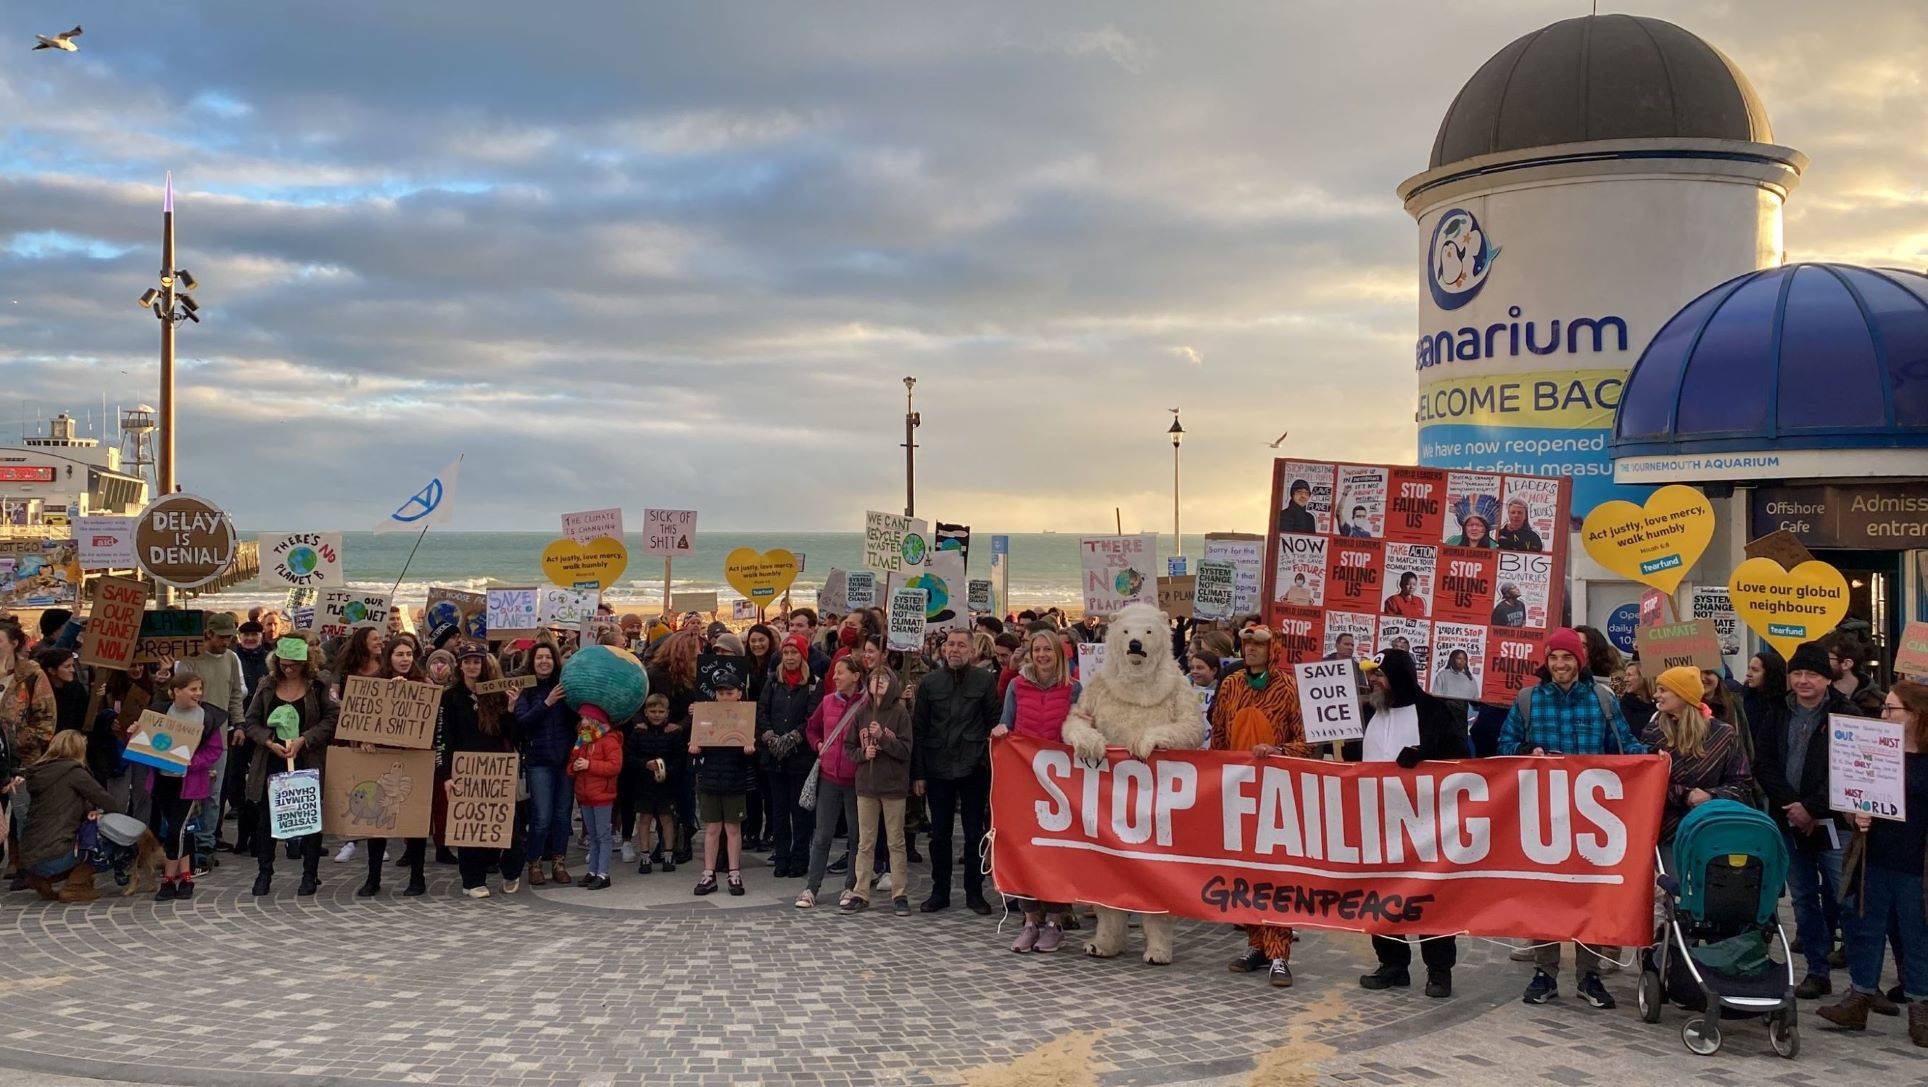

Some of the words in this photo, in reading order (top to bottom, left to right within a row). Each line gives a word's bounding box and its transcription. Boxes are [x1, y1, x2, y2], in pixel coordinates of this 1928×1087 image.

[1416, 384, 1520, 423] ELCOME
[1534, 378, 1622, 411] BAC
[1435, 442, 1461, 457] have
[1465, 441, 1500, 455] now
[1505, 434, 1604, 456] reopened
[1540, 463, 1613, 476] measu
[1704, 457, 1779, 469] AQUARIUM
[1401, 482, 1433, 499] STOP
[1392, 497, 1439, 515] FAILING
[1766, 502, 1825, 515] Offshore
[1852, 494, 1928, 513] Admiss
[152, 511, 223, 535] DELAY
[565, 517, 581, 527] THE
[584, 512, 616, 523] CLIMATE
[650, 511, 673, 522] SICK
[680, 512, 691, 523] OF
[867, 514, 882, 525] WE
[1406, 513, 1423, 529] US
[1588, 528, 1608, 542] Act
[1610, 521, 1644, 538] justly,
[1645, 514, 1668, 527] love
[1670, 505, 1705, 520] mercy,
[660, 524, 677, 535] THIS
[1780, 520, 1810, 533] Cafe
[175, 532, 190, 546] IS
[650, 536, 676, 549] SHIT
[867, 527, 901, 543] RECYCLE
[1617, 533, 1645, 548] walk
[1645, 523, 1686, 540] humbly
[16, 542, 40, 553] EGO
[273, 533, 320, 555] THERE'S
[319, 544, 336, 564] NO
[1084, 540, 1143, 553] THERE
[1208, 545, 1228, 555] Sorry
[1231, 545, 1241, 554] for
[1281, 537, 1325, 554] NOW
[1409, 545, 1436, 558] ACTION
[149, 545, 227, 566] DENIAL
[1106, 554, 1130, 568] IS
[1340, 551, 1371, 568] STOP
[582, 561, 608, 570] humbly
[728, 565, 740, 573] Act
[1200, 567, 1231, 576] SYSTEM
[1293, 564, 1325, 579] FUTURE
[1450, 560, 1482, 578] STOP
[1500, 554, 1551, 574] BIG
[1642, 556, 1680, 573] tearfund
[274, 563, 312, 585] PLANET
[313, 570, 325, 581] B
[759, 570, 781, 578] humbly
[1199, 575, 1232, 583] CHANGE
[1332, 566, 1377, 584] FAILING
[1498, 572, 1548, 583] COUNTRIES
[1199, 581, 1214, 589] NOT
[1345, 582, 1361, 597] US
[1442, 576, 1489, 595] FAILING
[1736, 581, 1766, 594] Love
[1769, 586, 1792, 595] our
[1796, 586, 1841, 599] global
[102, 585, 144, 607] SAVE
[327, 592, 352, 603] IT'S
[364, 597, 384, 608] OUR
[489, 591, 531, 610] SAVE
[894, 596, 924, 605] SYSTEM
[1198, 589, 1232, 598] CLIMATE
[1198, 596, 1231, 605] CHANGE
[1454, 593, 1473, 608] US
[103, 604, 135, 623] OUR
[500, 606, 521, 615] OUR
[893, 603, 924, 612] CHANGE
[1694, 603, 1735, 612] CHANGE
[1694, 611, 1713, 619] NOT
[1749, 599, 1826, 616] neighbours
[487, 612, 532, 628] PLANET
[891, 618, 924, 627] CLIMATE
[1619, 611, 1640, 620] Ope
[89, 617, 140, 641] PLANET
[320, 624, 350, 636] SAVE
[891, 625, 923, 634] CHANGE
[1282, 619, 1312, 637] STOP
[1463, 628, 1483, 637] STOP
[1608, 624, 1632, 633] daily
[1649, 625, 1698, 640] CLIMATE
[1770, 625, 1804, 637] tearfund
[95, 638, 131, 662] NOW
[133, 639, 202, 659] PROFIT
[1287, 648, 1303, 664] US
[1500, 641, 1533, 660] STOP
[1664, 655, 1693, 669] NOW!
[1304, 663, 1346, 679] SAVE
[499, 678, 525, 690] VEGAN
[1505, 673, 1524, 690] US
[351, 678, 379, 697] THIS
[385, 679, 440, 703] PLANET
[1310, 685, 1347, 700] OUR
[344, 696, 383, 715] NEEDS
[391, 699, 411, 718] YOU
[415, 704, 432, 719] TO
[1316, 703, 1351, 723] ICE
[341, 715, 371, 732] GIVE
[374, 717, 382, 729] A
[386, 718, 425, 739] SHIT!
[1835, 730, 1854, 741] OUR
[1878, 736, 1900, 748] MUST
[455, 756, 516, 776] CLIMATE
[275, 786, 316, 800] CHANGE
[452, 779, 509, 798] CHANGE
[1844, 787, 1864, 799] MUST
[275, 794, 317, 807] CLIMATE
[297, 802, 317, 811] NOT
[1032, 749, 1197, 846] STOP
[1222, 764, 1491, 864] FAILING
[1517, 768, 1627, 867] US
[1852, 798, 1898, 816] WORLD
[276, 809, 318, 822] CHANGE
[454, 802, 509, 823] COSTS
[279, 816, 318, 829] SYSTEM
[454, 822, 502, 842] LIVES
[1201, 875, 1435, 923] GREENPEACE
